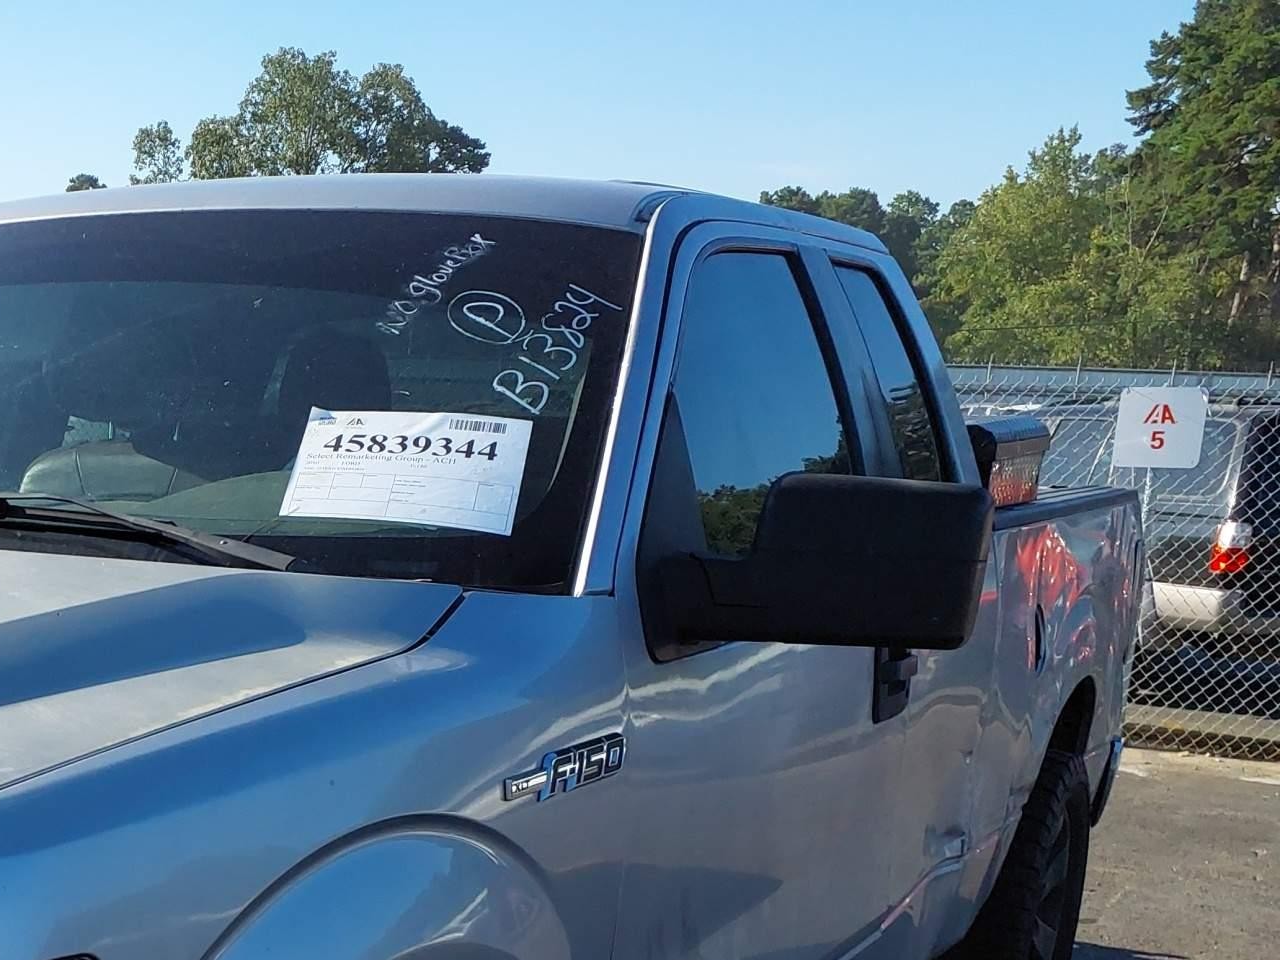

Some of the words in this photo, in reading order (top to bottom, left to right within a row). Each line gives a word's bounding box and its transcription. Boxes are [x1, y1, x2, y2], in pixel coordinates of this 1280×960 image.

[463, 302, 514, 338] P
[323, 433, 498, 460] 45839344
[1150, 431, 1165, 449] 5
[306, 452, 334, 460] Select
[336, 453, 393, 463] Remarketing
[395, 455, 424, 464] Group
[514, 779, 529, 793] XLT
